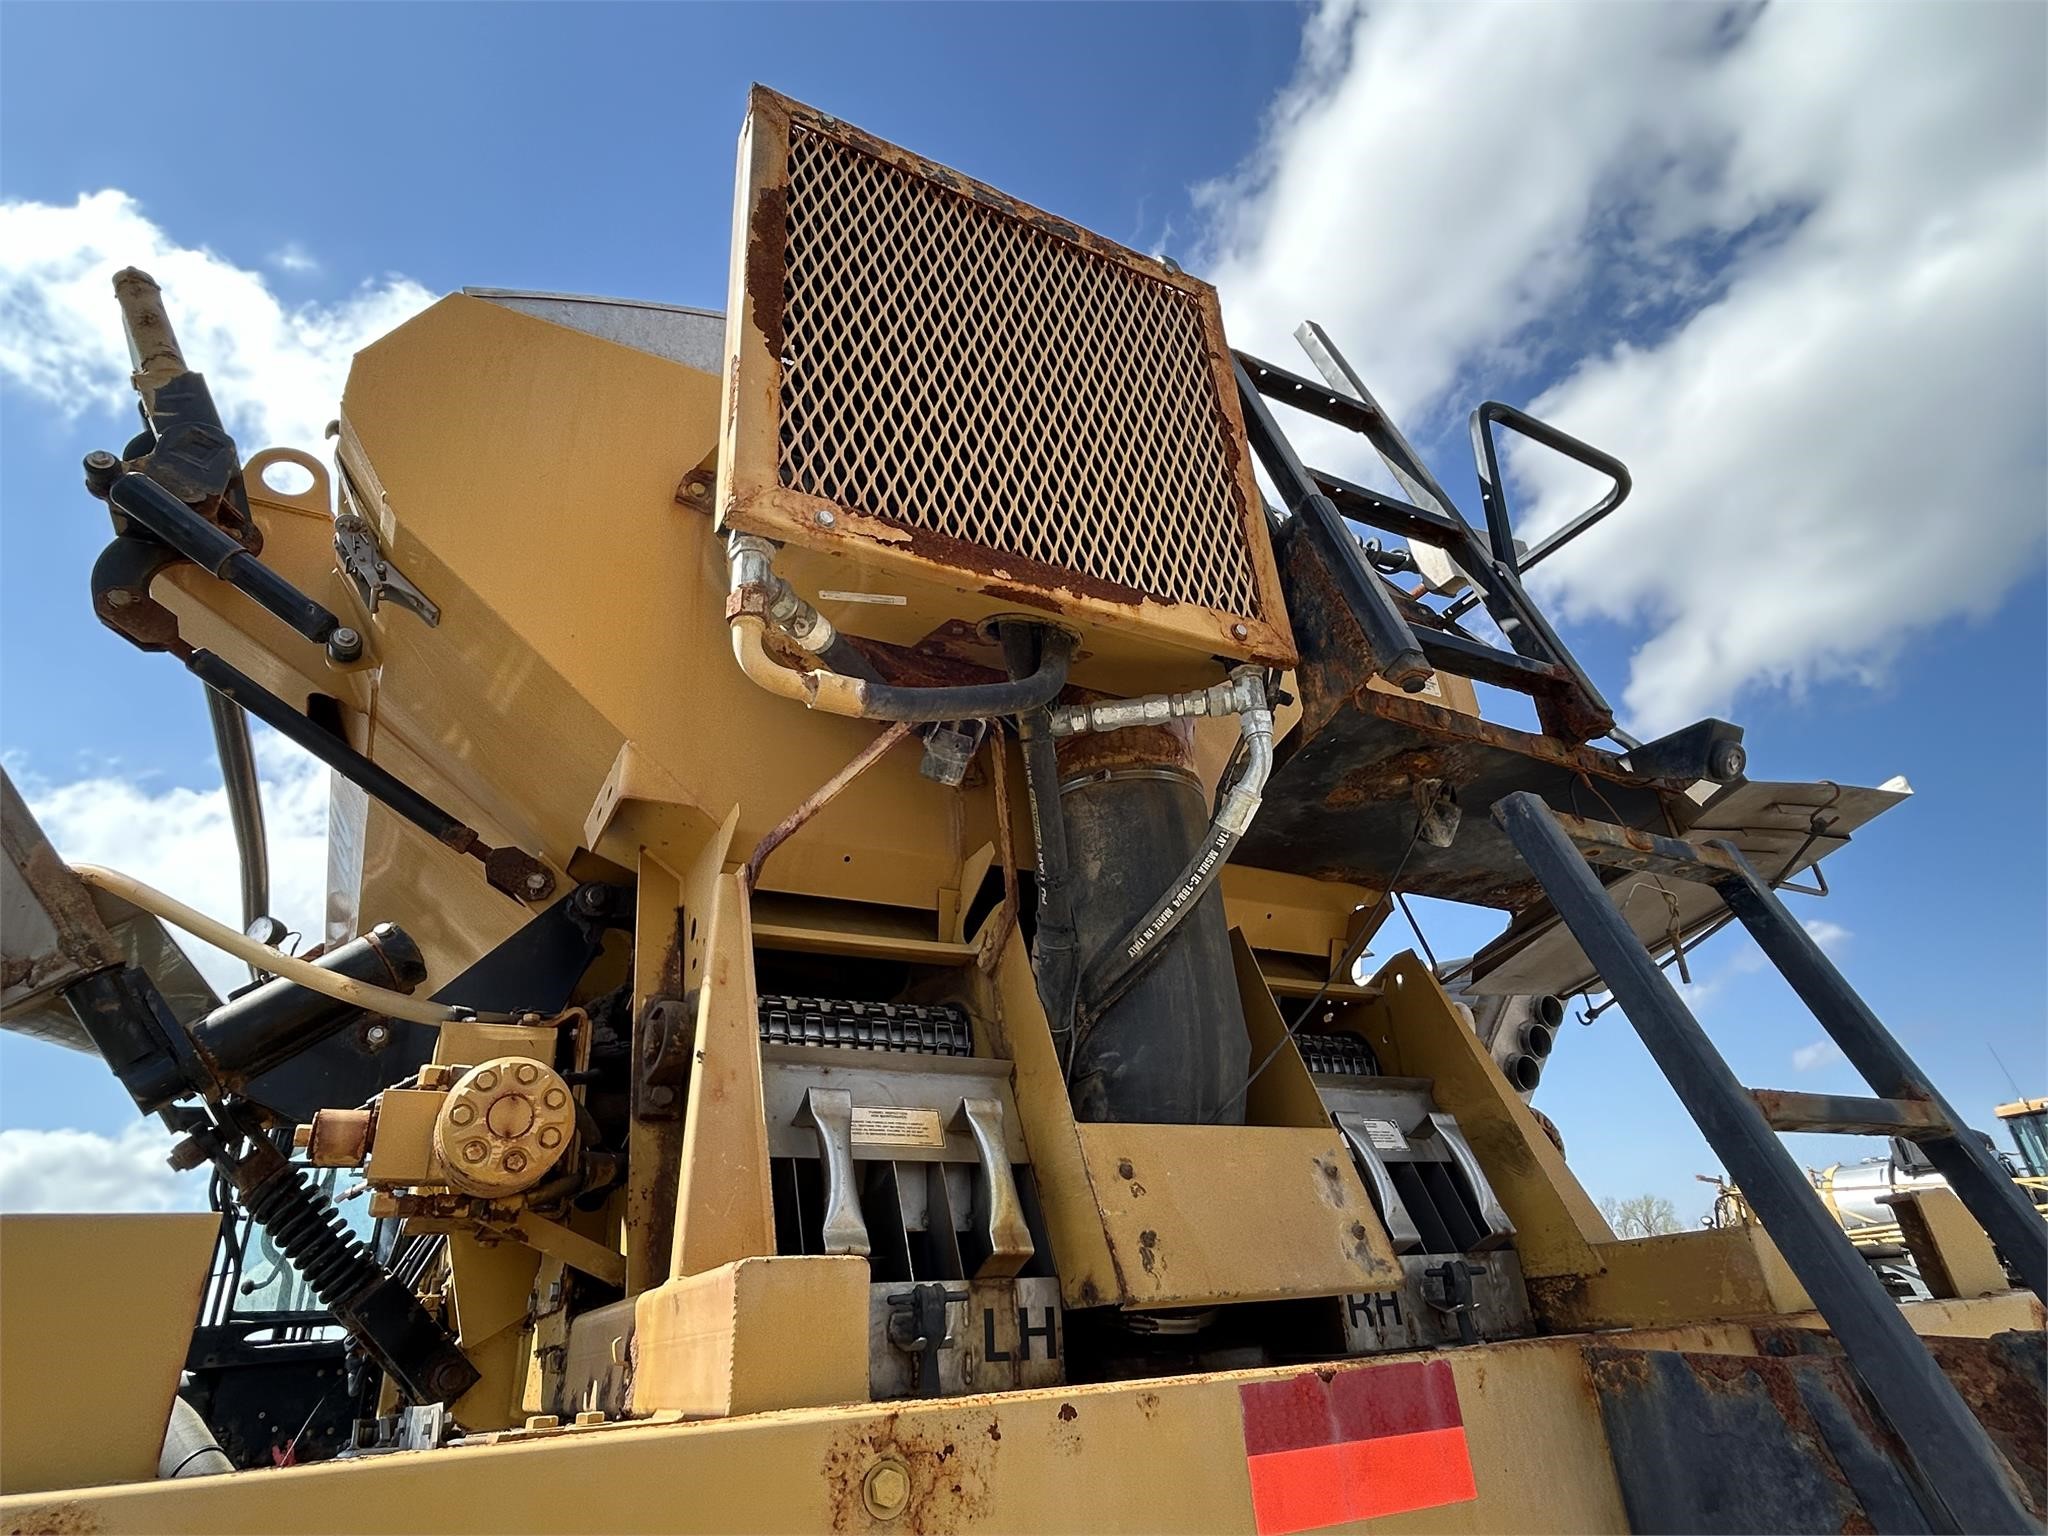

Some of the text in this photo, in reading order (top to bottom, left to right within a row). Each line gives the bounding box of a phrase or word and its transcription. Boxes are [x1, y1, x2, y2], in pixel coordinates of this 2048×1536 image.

[1215, 831, 1230, 848] 1AT
[1197, 849, 1219, 875] MSHA
[1152, 907, 1174, 931] MADE
[1143, 928, 1156, 940] IN
[1127, 937, 1147, 958] ITALY
[1347, 1291, 1403, 1329] RH
[984, 1306, 1057, 1362] LH
